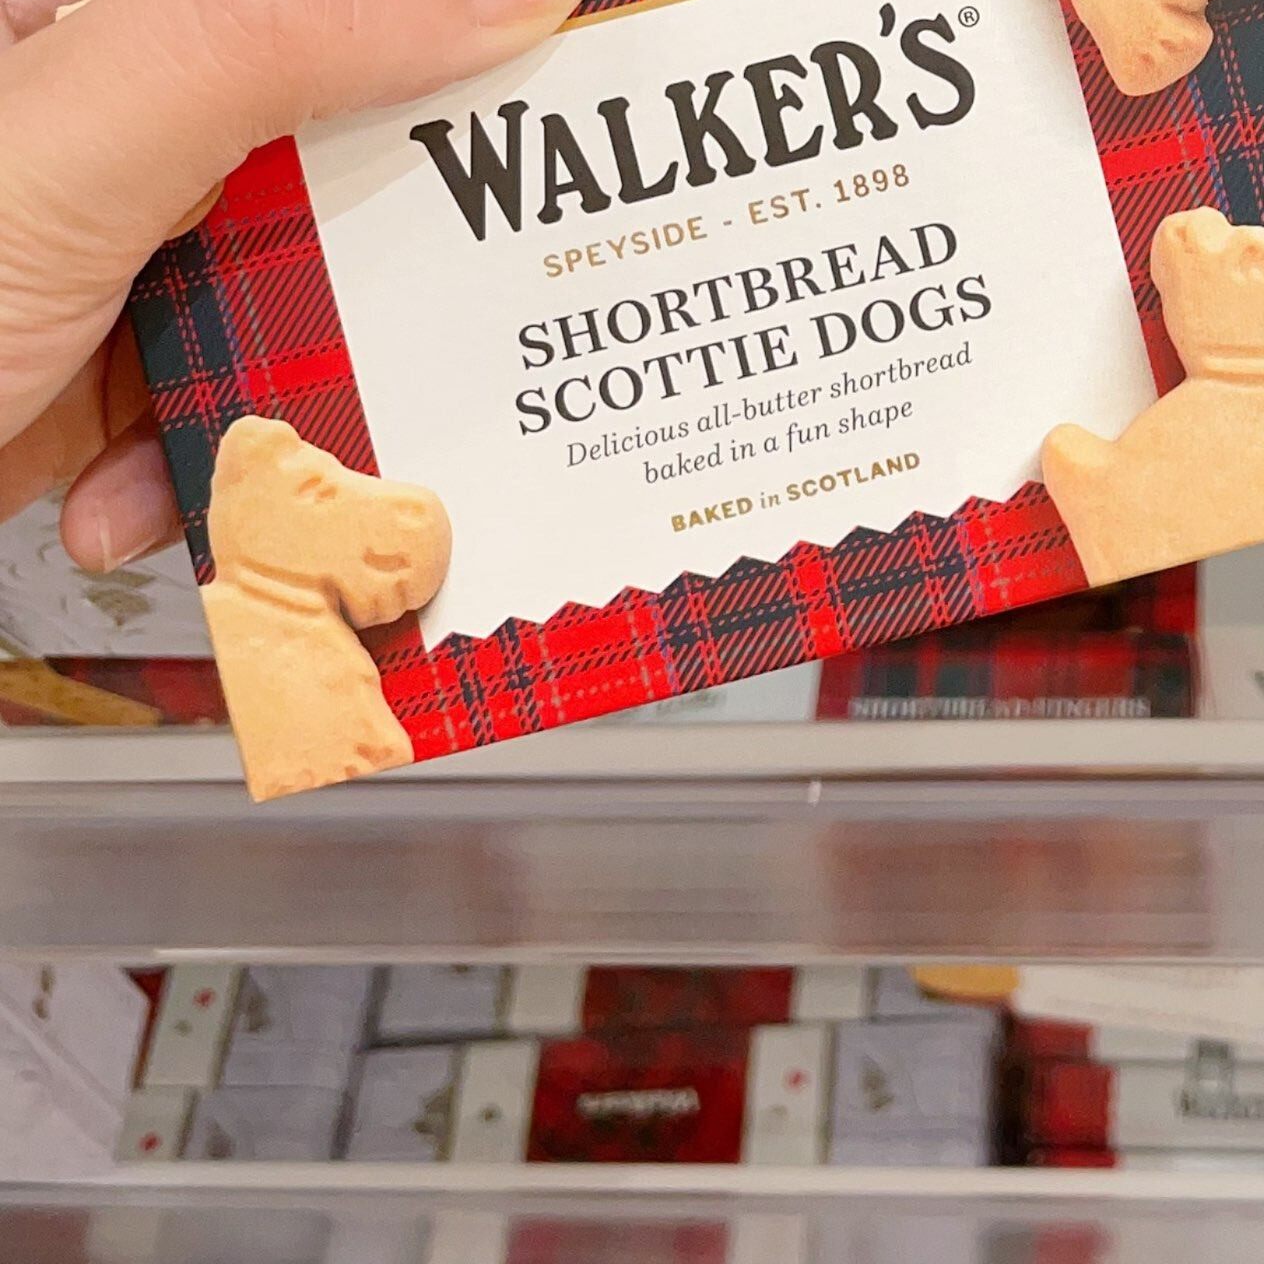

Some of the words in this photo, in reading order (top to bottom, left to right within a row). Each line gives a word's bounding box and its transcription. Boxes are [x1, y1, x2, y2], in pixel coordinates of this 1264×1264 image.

[542, 215, 708, 279] SPEYSIDE
[747, 189, 822, 227] EST.
[835, 163, 911, 207] 1898
[515, 324, 799, 436] SCOTTIE
[810, 273, 993, 359] DOGS
[518, 221, 958, 371] SHORTBREAD
[566, 418, 690, 469] Delicious
[696, 385, 822, 432] all-butter
[829, 343, 973, 399] shortbread
[643, 444, 724, 486] baked
[730, 436, 756, 463] in
[762, 436, 780, 456] a
[785, 418, 832, 460] fun
[837, 399, 914, 445] shape
[671, 497, 753, 533] BAKED
[758, 489, 781, 510] in
[785, 450, 921, 503] SCOTLAND
